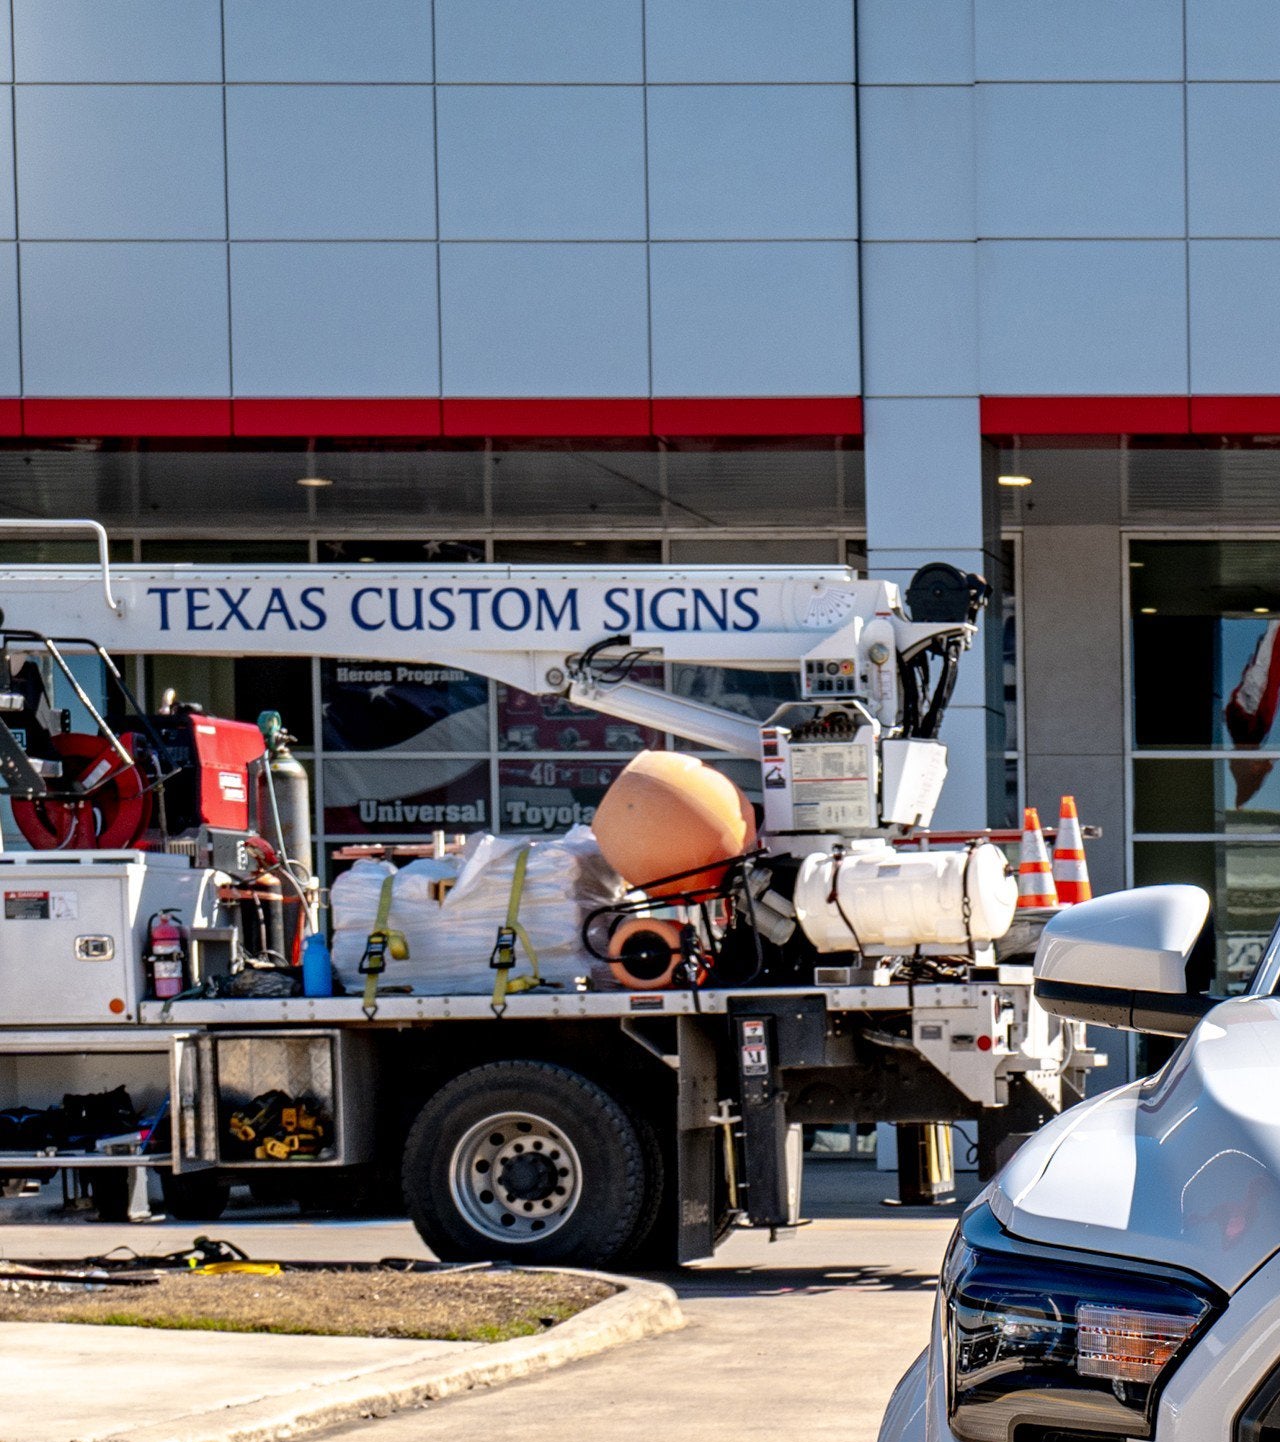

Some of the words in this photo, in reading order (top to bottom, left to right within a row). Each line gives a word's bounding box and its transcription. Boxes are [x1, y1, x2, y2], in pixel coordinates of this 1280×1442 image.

[147, 586, 327, 632] TEXAS
[351, 586, 581, 632] CUSTOM
[603, 586, 761, 632] SIGNS
[337, 667, 393, 683] Heroes
[396, 667, 470, 686] Program.
[359, 799, 485, 823] Universal
[507, 801, 596, 830] Toyota
